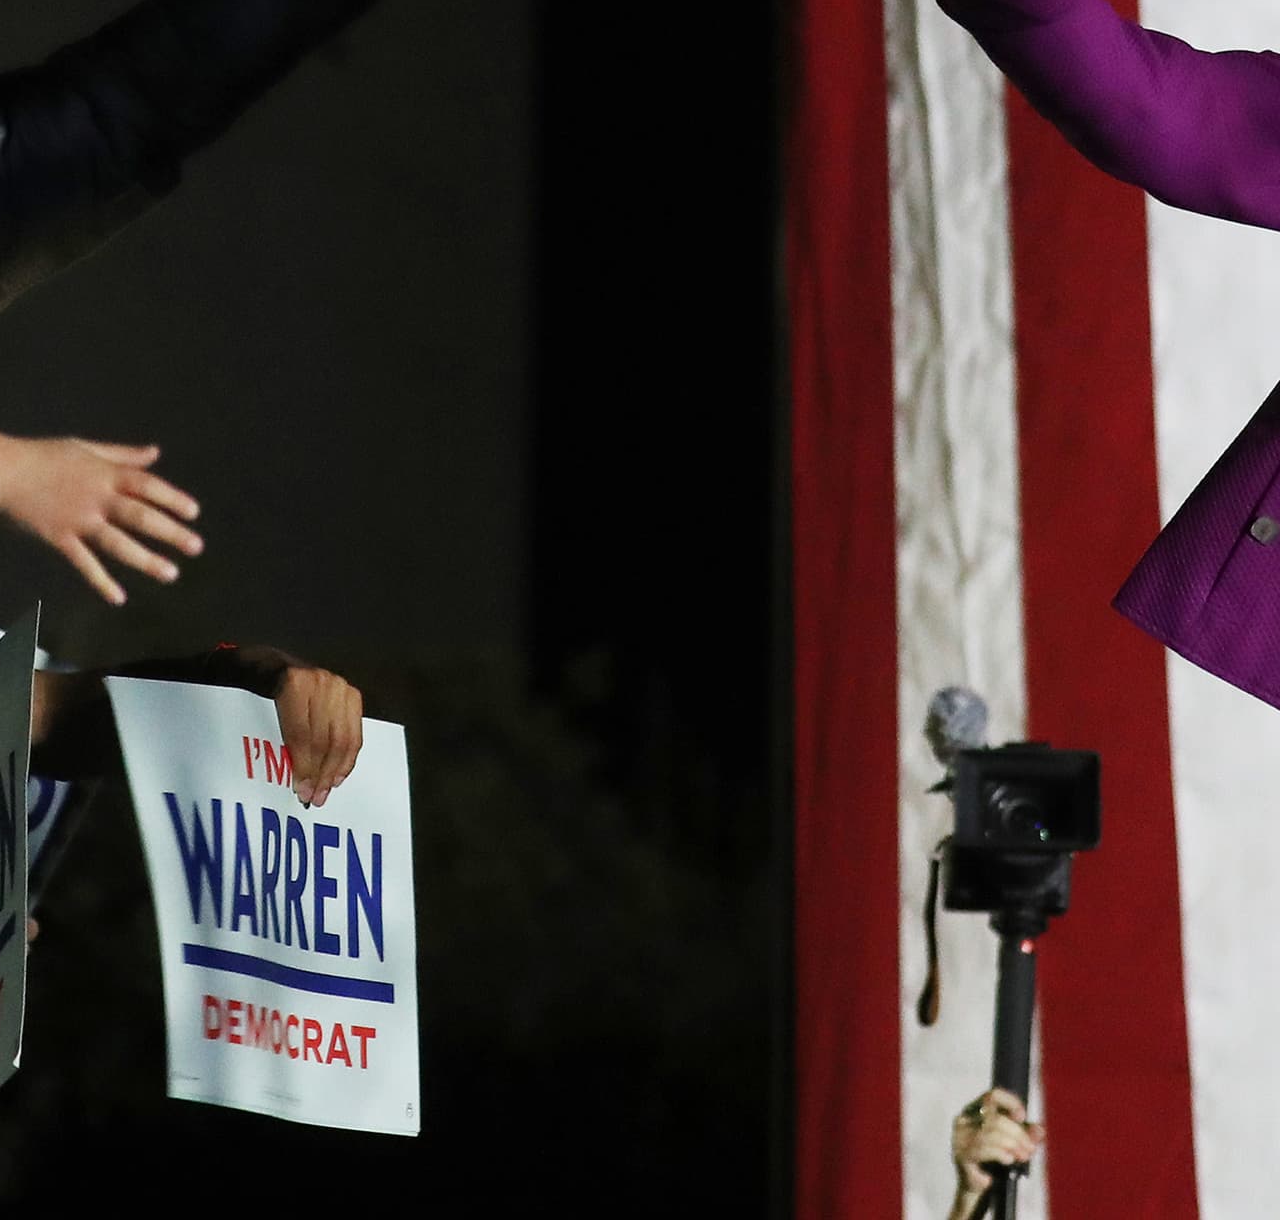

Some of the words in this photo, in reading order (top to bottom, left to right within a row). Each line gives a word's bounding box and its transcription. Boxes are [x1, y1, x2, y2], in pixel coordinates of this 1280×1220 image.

[242, 735, 294, 787] I'M
[163, 792, 384, 963] WARREN
[201, 994, 377, 1069] DEMOCRAT
